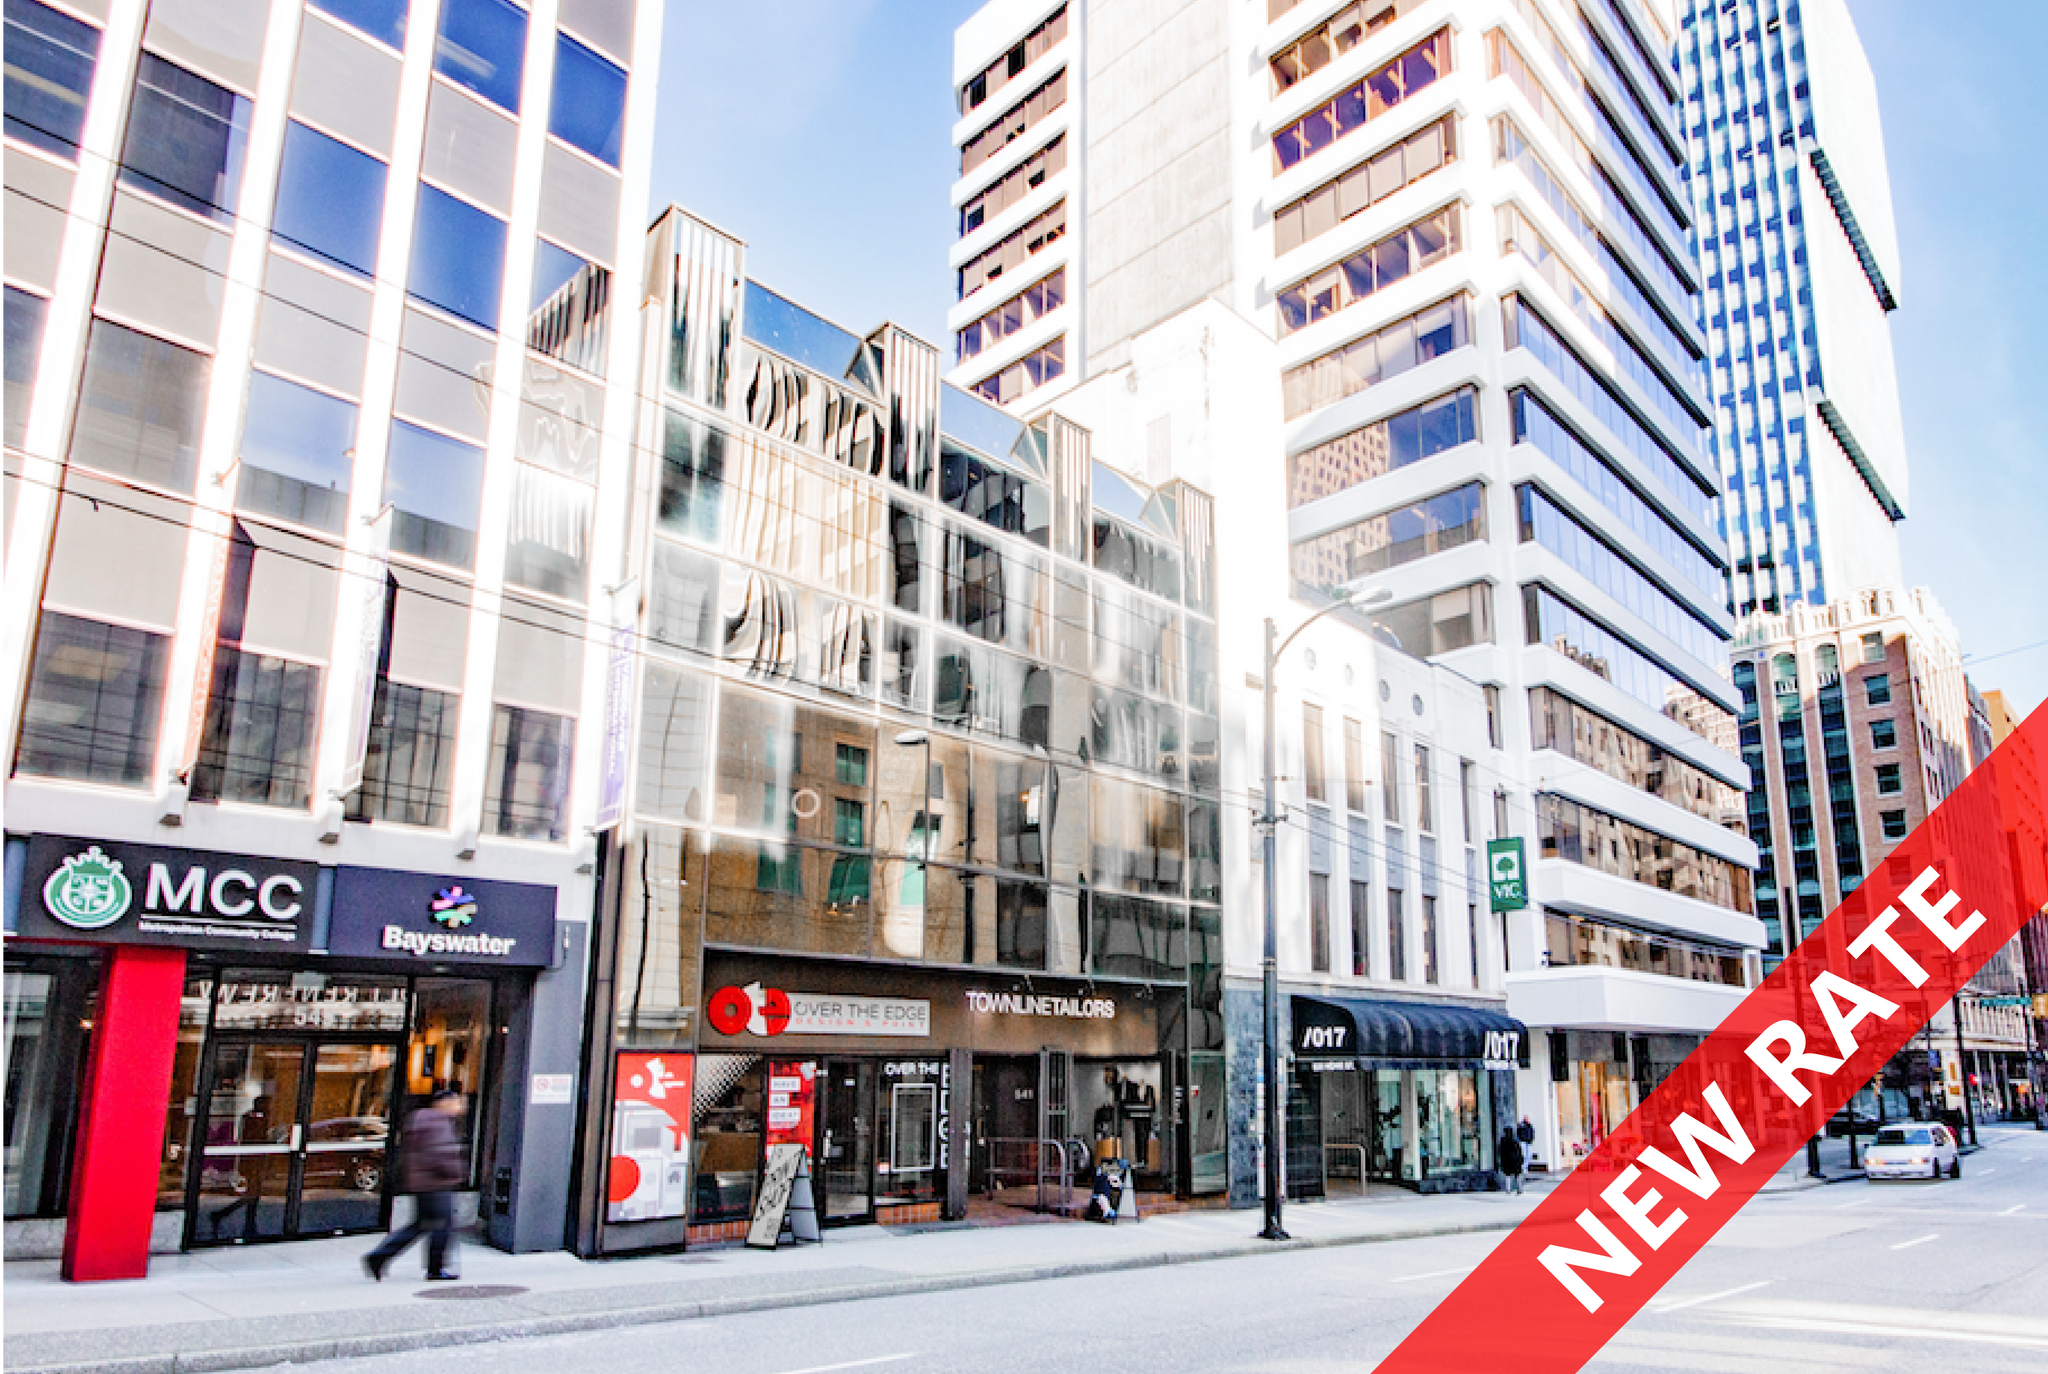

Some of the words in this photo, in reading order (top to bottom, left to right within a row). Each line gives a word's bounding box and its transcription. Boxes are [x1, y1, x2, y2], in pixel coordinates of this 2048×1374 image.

[145, 862, 304, 919] MCC
[382, 924, 517, 956] Bayswater
[794, 1001, 842, 1016] OVER
[848, 1003, 879, 1019] THE
[884, 1004, 926, 1021] EDGE
